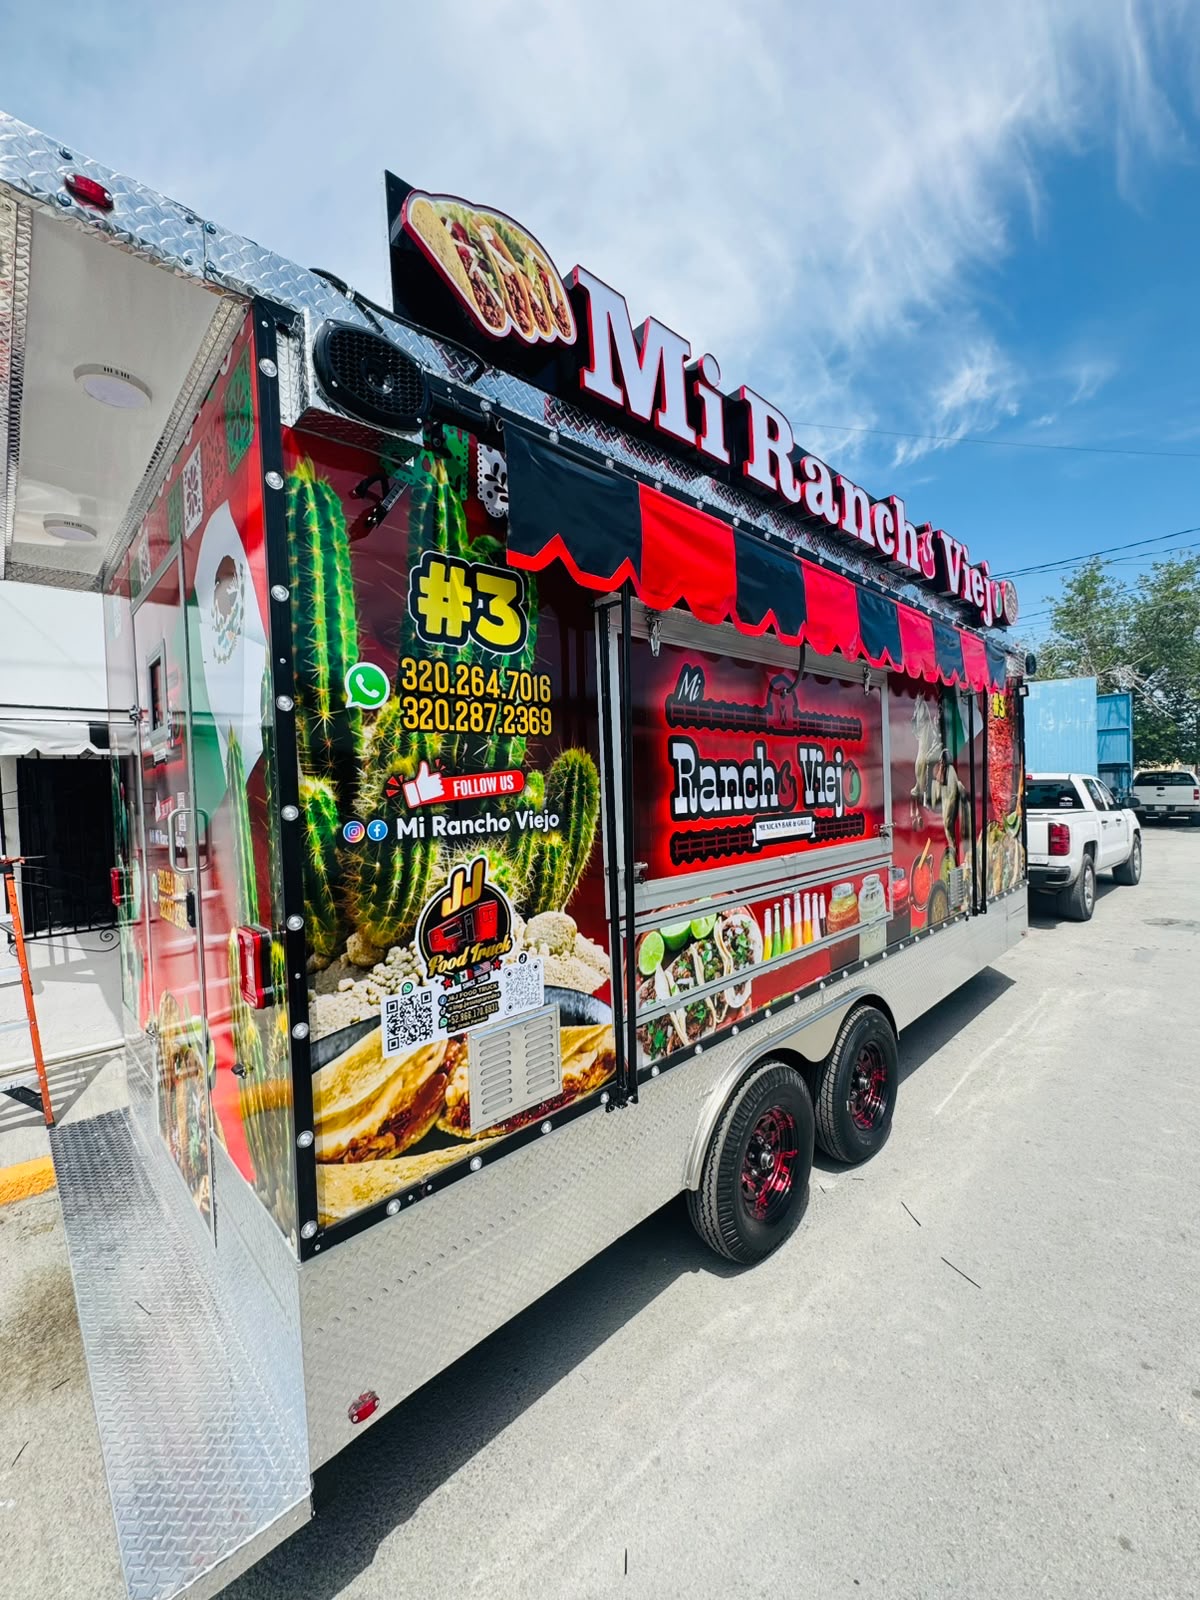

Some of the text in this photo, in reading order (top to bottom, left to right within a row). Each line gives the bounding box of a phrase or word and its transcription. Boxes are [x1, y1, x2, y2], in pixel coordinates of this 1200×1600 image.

[573, 264, 730, 464] Mi
[418, 561, 521, 646] #3
[401, 657, 551, 703] 320.264.7016
[678, 671, 702, 703] Mi
[402, 696, 552, 736] 320.287.2369
[453, 775, 515, 797] FOLLOW US
[396, 810, 560, 840] Mi Rancho Viejo
[428, 934, 512, 977] Food Truck
[459, 987, 478, 999] FOOD
[478, 983, 498, 994] TRUCK
